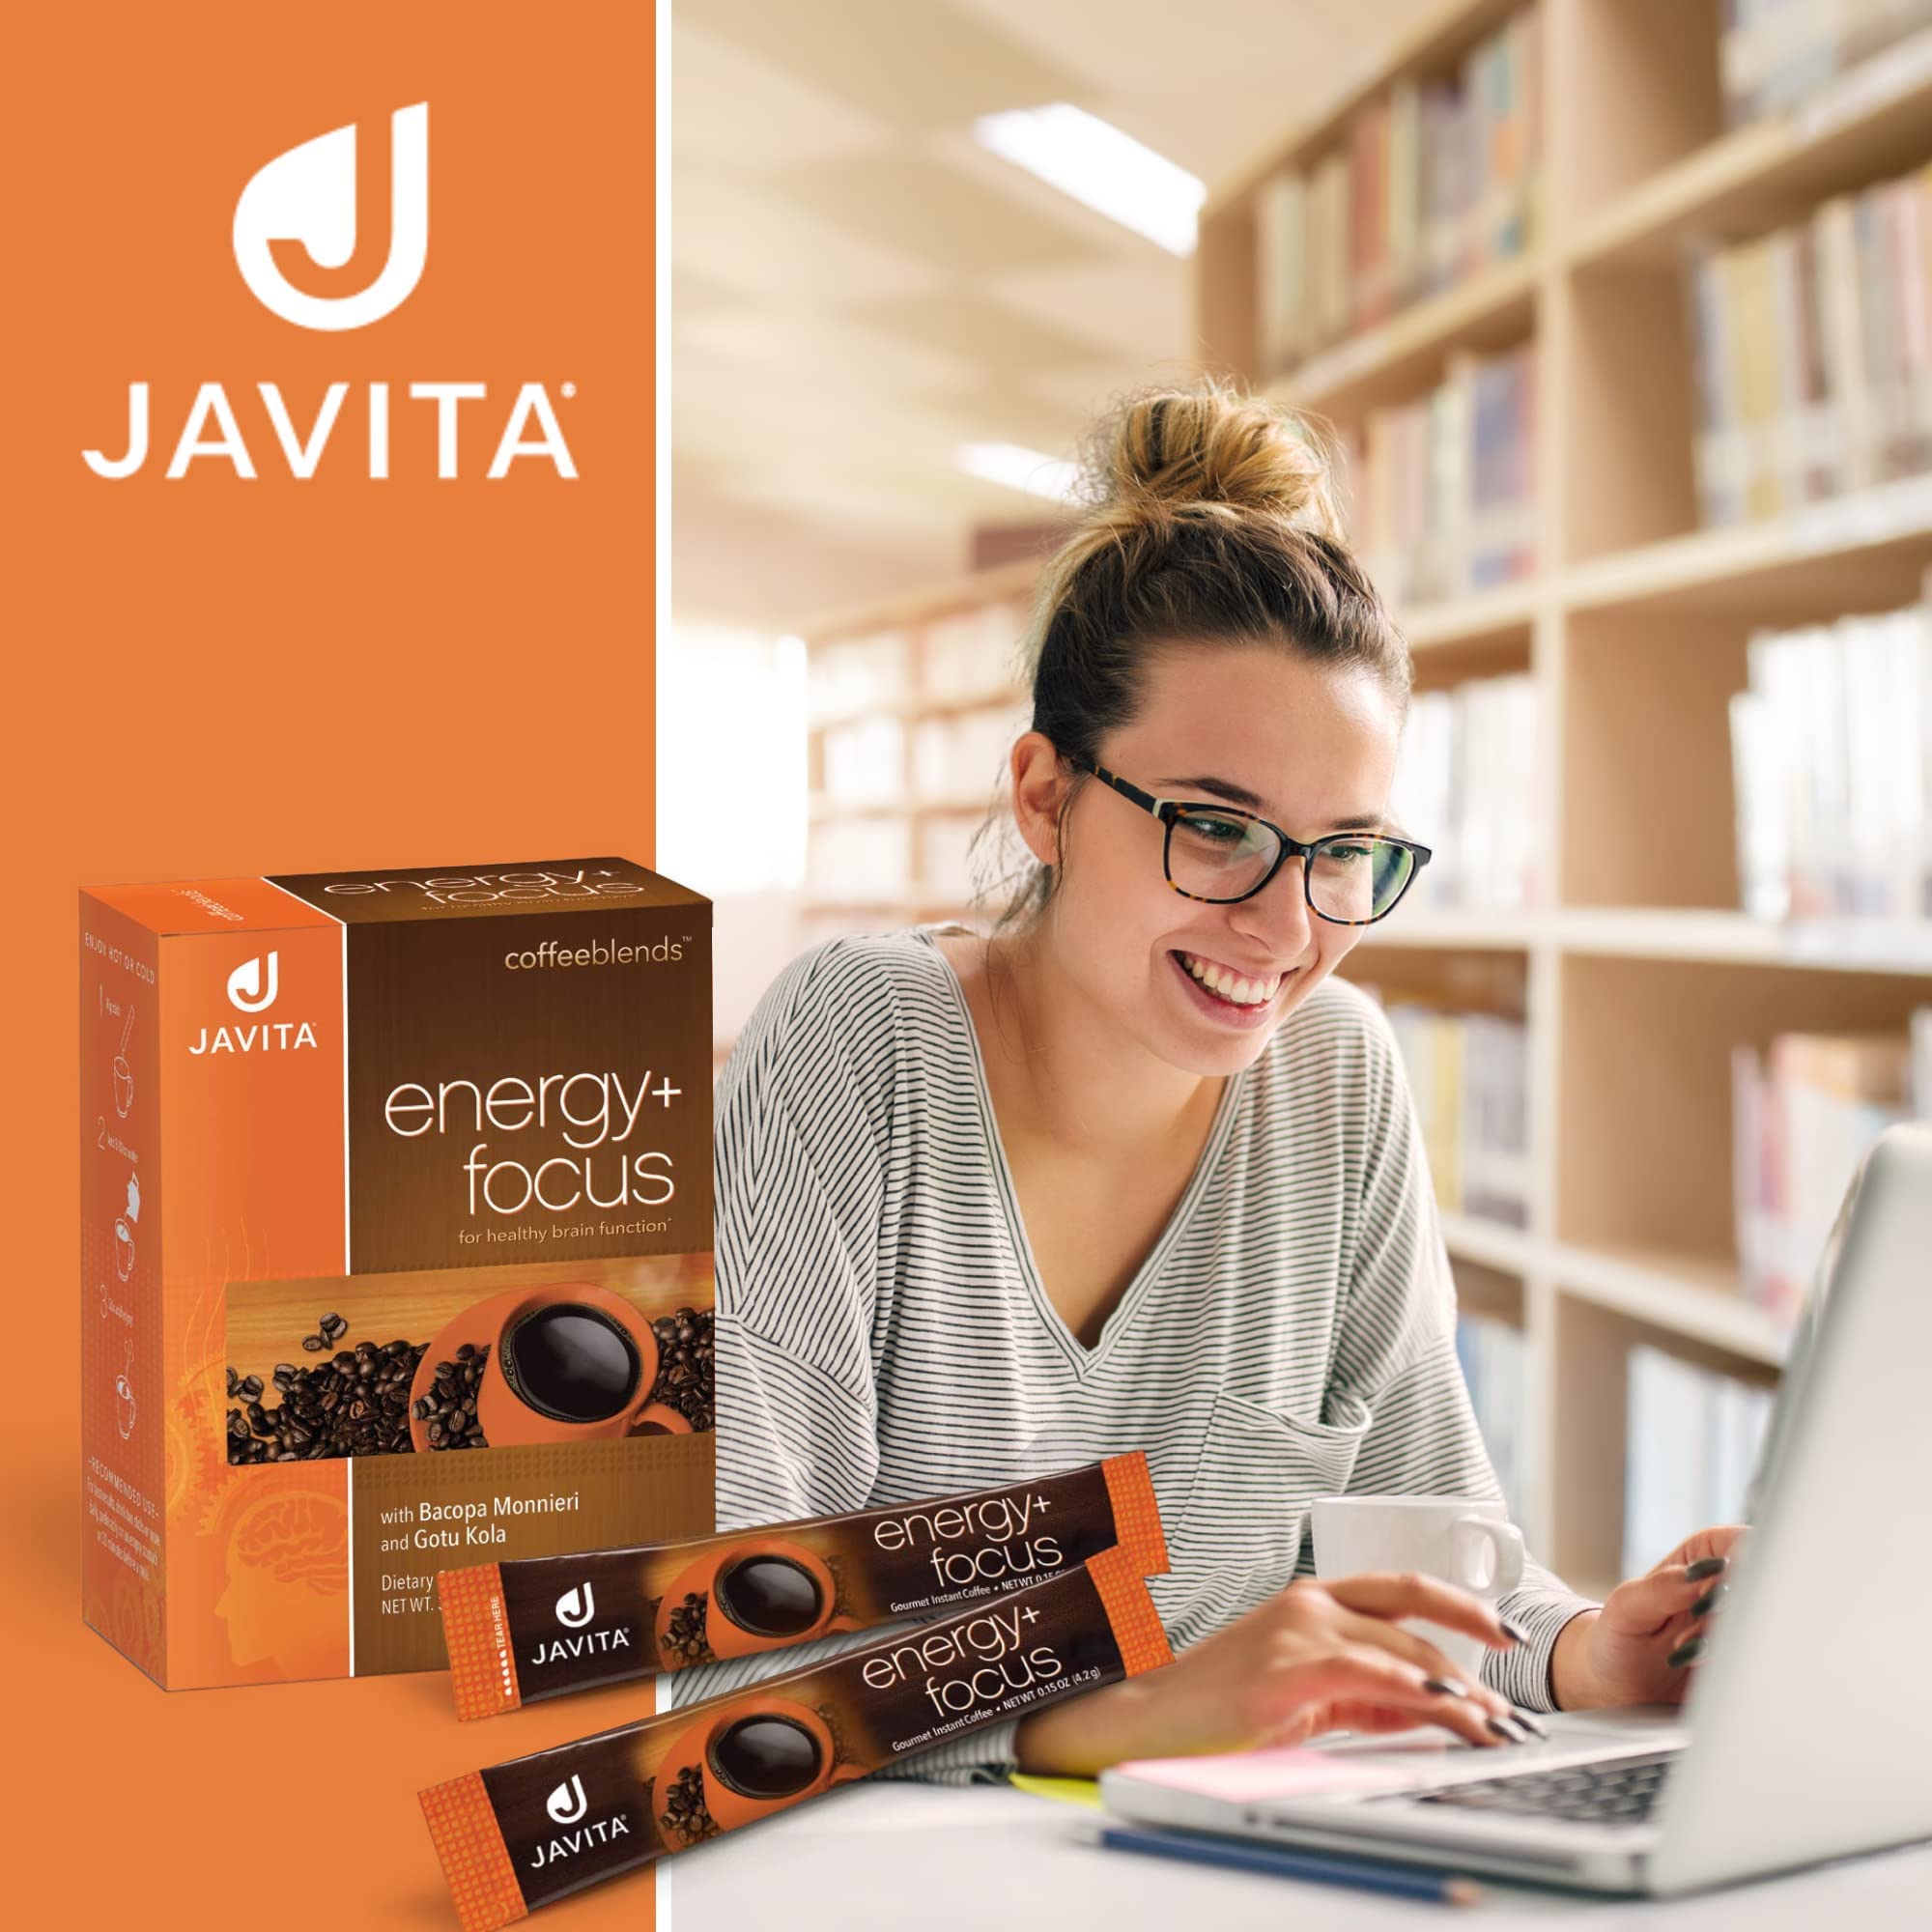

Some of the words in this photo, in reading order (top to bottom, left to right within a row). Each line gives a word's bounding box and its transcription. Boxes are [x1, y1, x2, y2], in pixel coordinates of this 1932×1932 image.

[425, 882, 645, 905] focus
[84, 931, 107, 956] ENJOY
[107, 945, 124, 966] HOT
[123, 956, 136, 974] OR
[135, 961, 156, 985] COLD
[384, 1070, 682, 1150] energy+
[97, 1115, 106, 1151] 2
[464, 1144, 675, 1215] focus
[458, 1230, 483, 1245] for
[487, 1226, 548, 1244] healthy
[553, 1223, 595, 1239] brain
[99, 1284, 108, 1320] 3
[381, 1505, 414, 1524] with
[418, 1500, 488, 1523] Bacopa
[493, 1492, 580, 1517] Monnieri
[873, 1493, 1052, 1551] energy+
[381, 1533, 410, 1552] and
[413, 1528, 460, 1549] Gotu
[466, 1523, 506, 1546] Kola
[929, 1536, 1064, 1587] focus
[382, 1573, 434, 1591] Dietary
[891, 1598, 930, 1613] Gourmet
[930, 1590, 963, 1605] Instant
[962, 1584, 991, 1600] Coffee
[382, 1599, 407, 1614] NET
[408, 1596, 435, 1612] WT.
[491, 1596, 500, 1623] HERE
[495, 1623, 507, 1648] TEAR
[862, 1605, 1041, 1690] energy+
[924, 1646, 1063, 1718] focus
[891, 1730, 933, 1752] Gourmet
[932, 1718, 966, 1737] Instant
[963, 1706, 994, 1725] Coffee
[1037, 1683, 1058, 1698] 0.15
[1057, 1677, 1072, 1690] OZ
